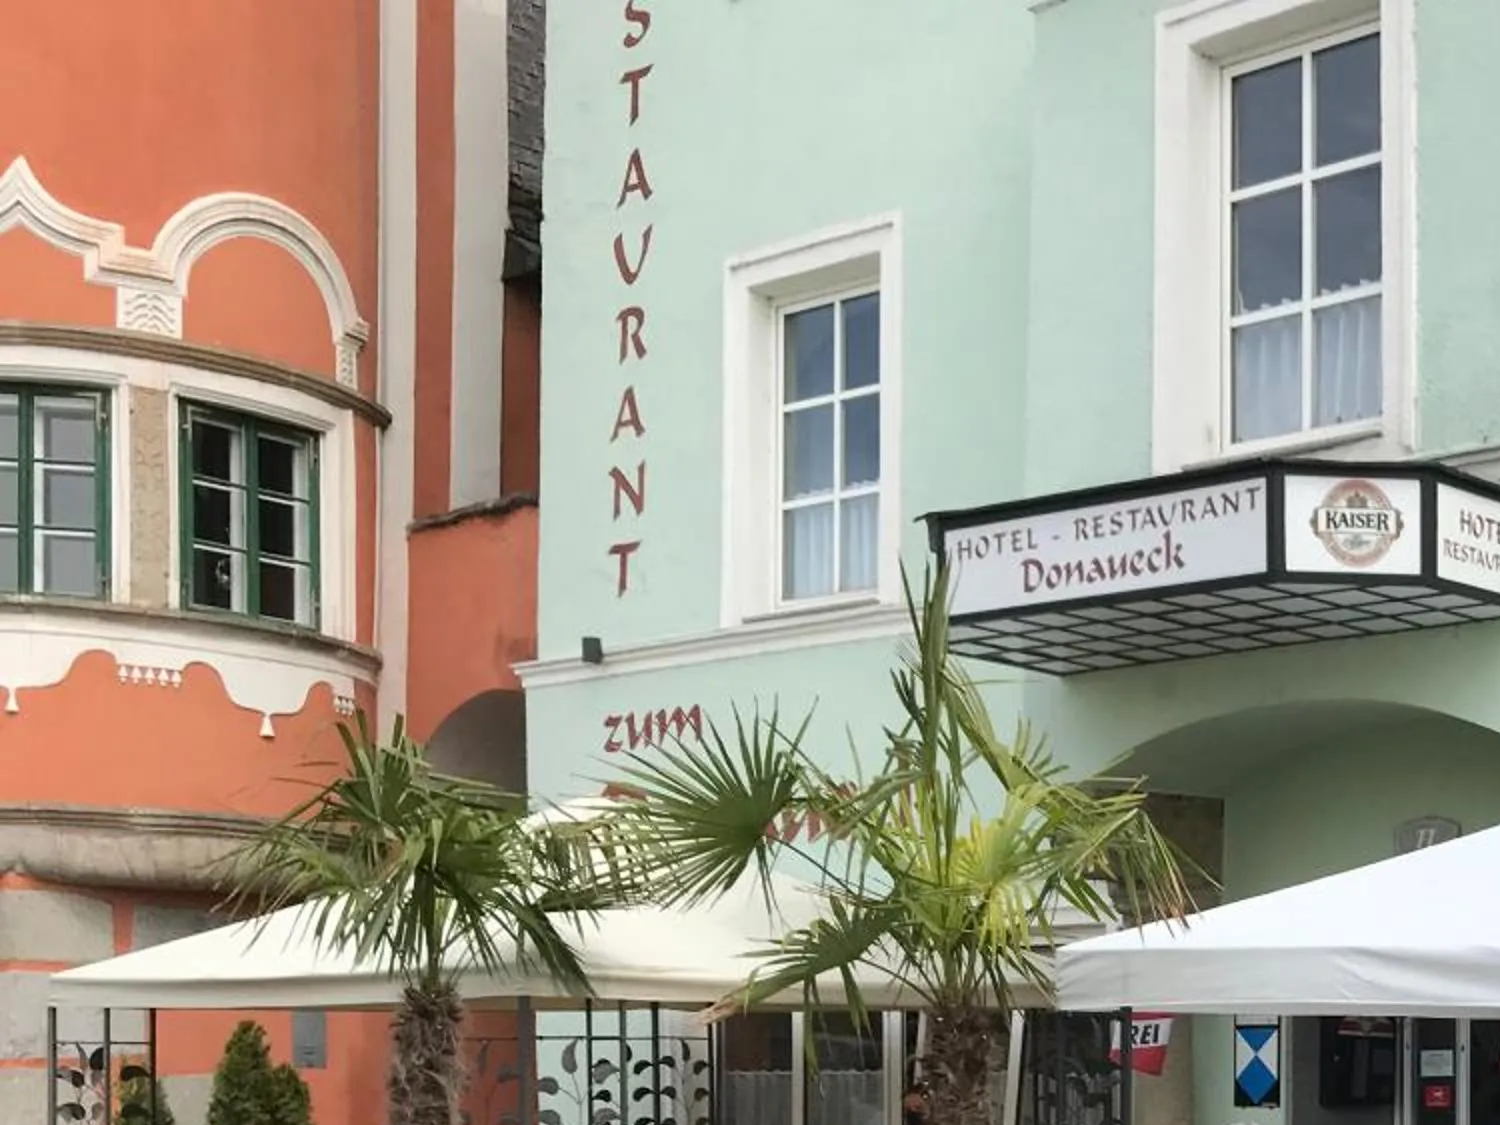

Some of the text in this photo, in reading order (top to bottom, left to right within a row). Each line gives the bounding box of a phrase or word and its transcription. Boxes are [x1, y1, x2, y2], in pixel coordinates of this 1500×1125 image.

[1325, 509, 1390, 531] KAISER
[957, 527, 1039, 562] HOTEL
[1021, 529, 1186, 594] Donaueck
[1129, 1023, 1160, 1045] REI
